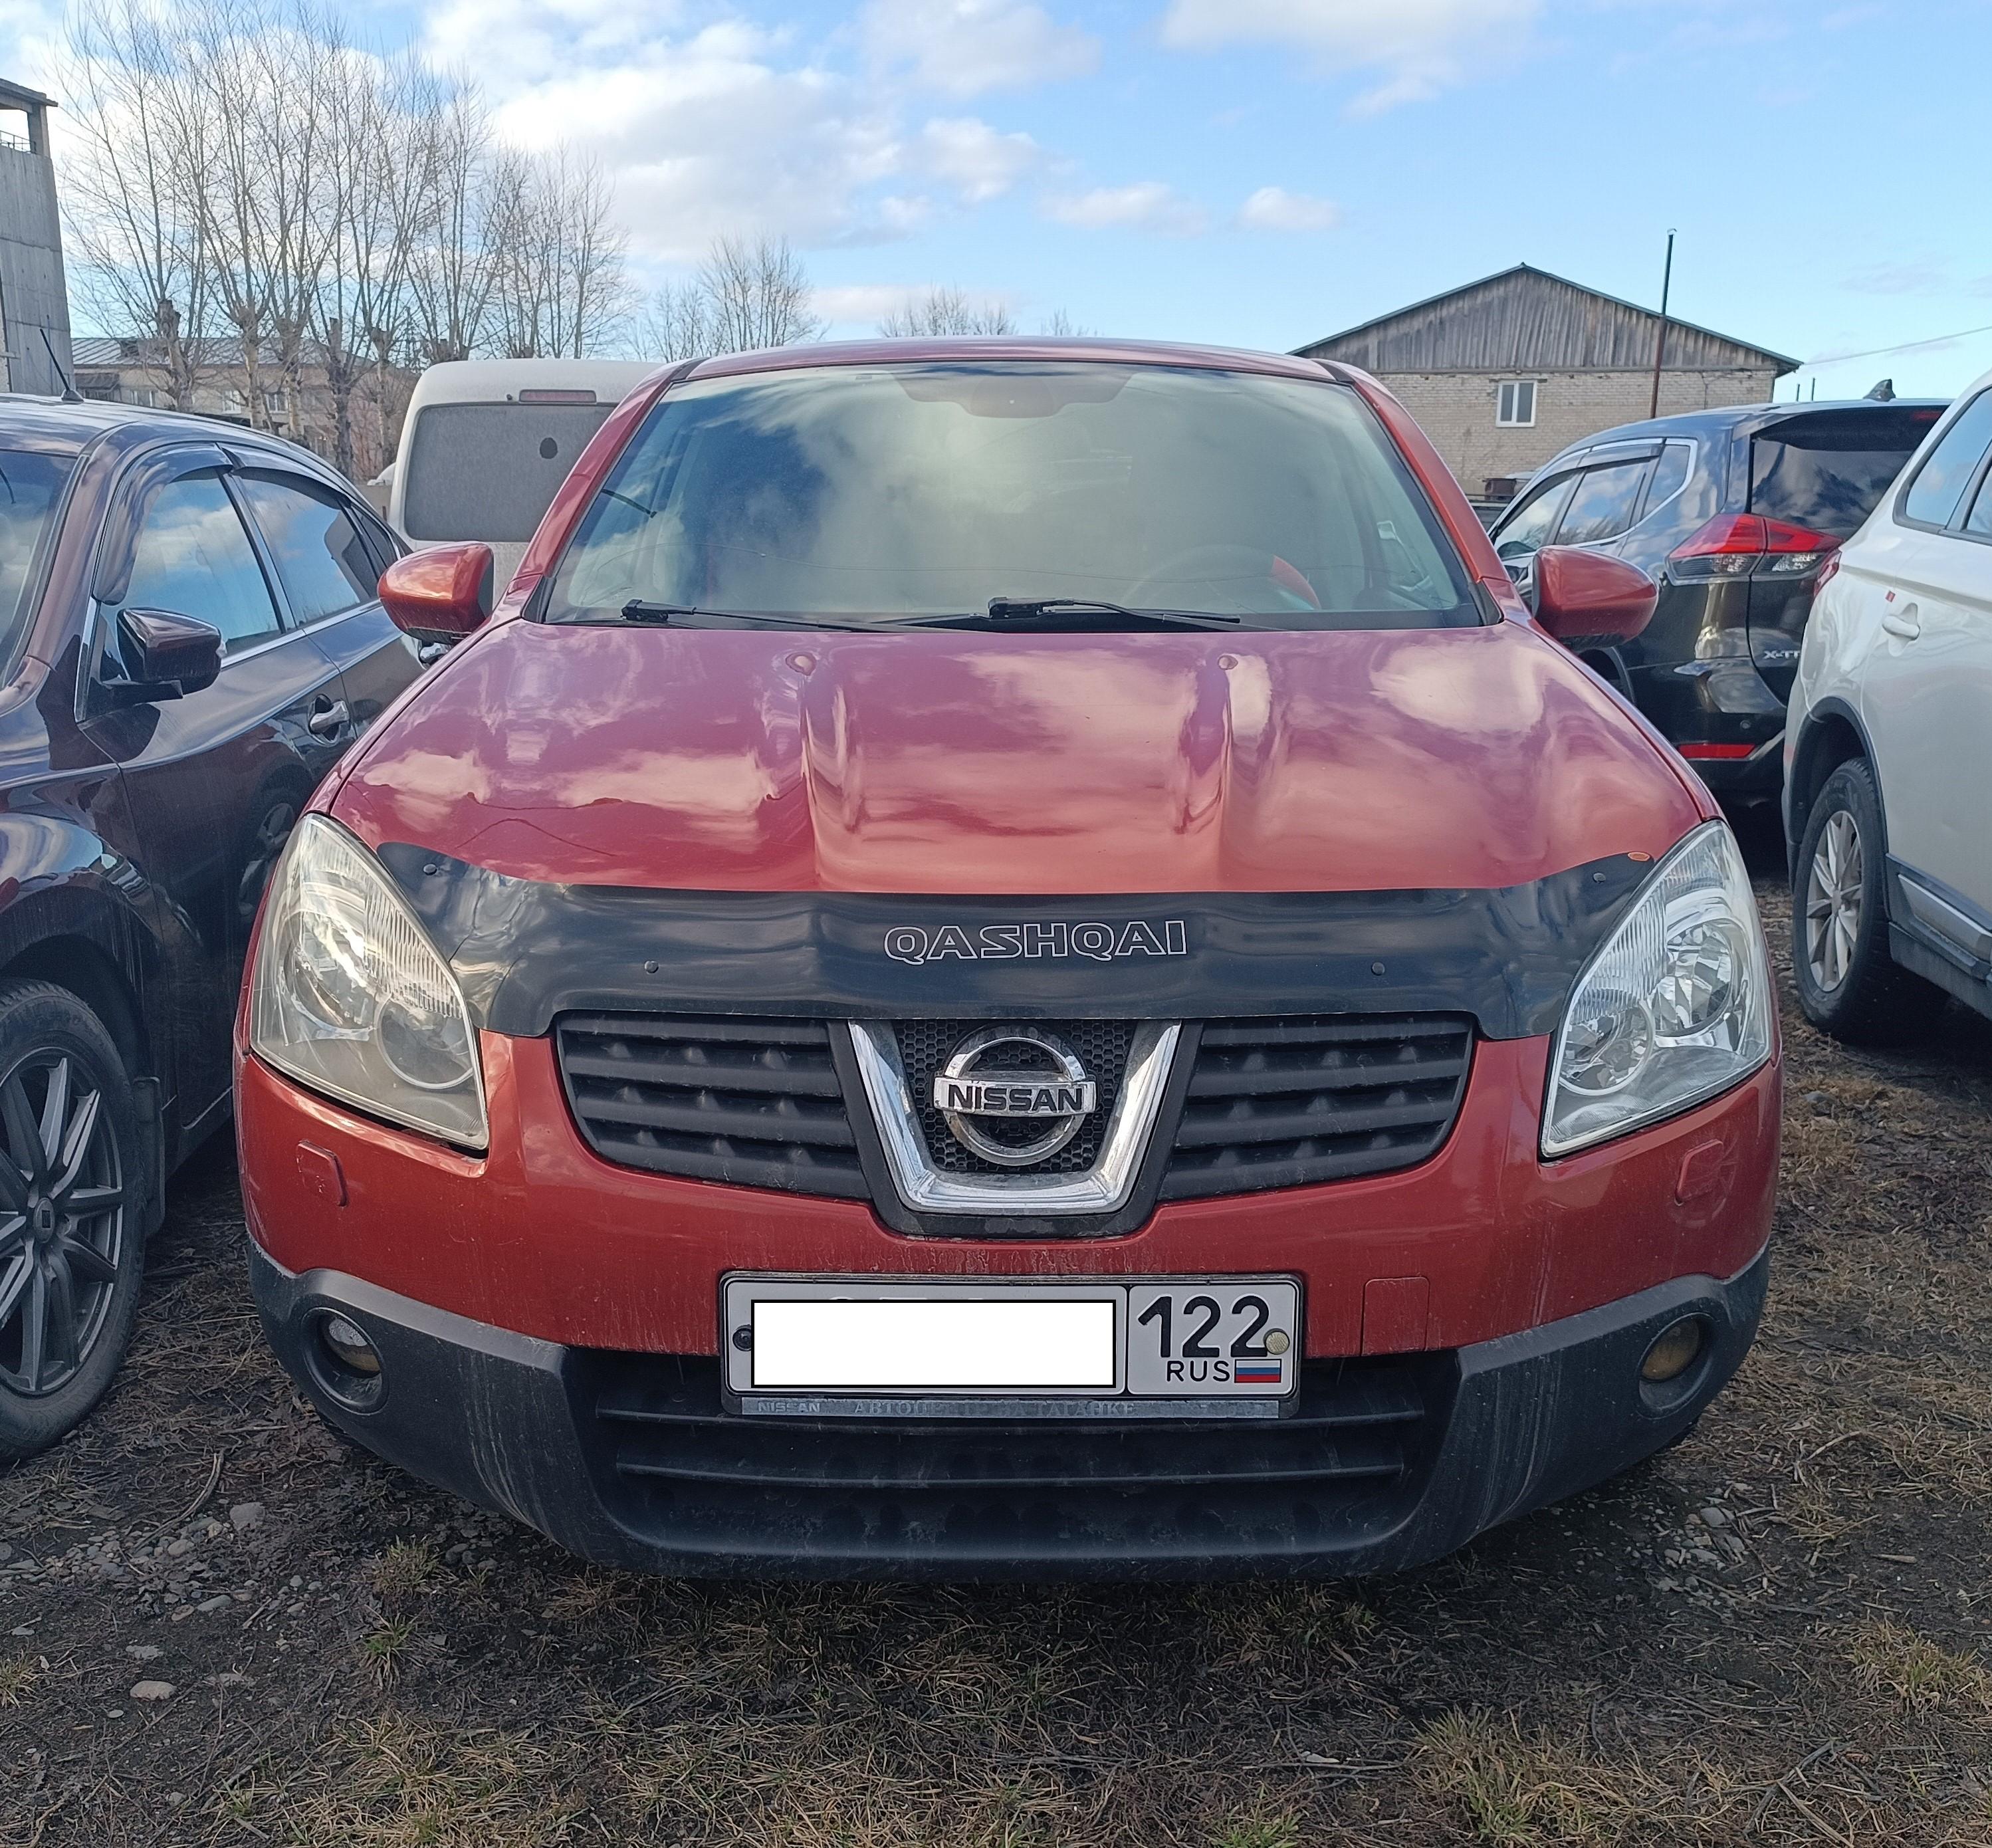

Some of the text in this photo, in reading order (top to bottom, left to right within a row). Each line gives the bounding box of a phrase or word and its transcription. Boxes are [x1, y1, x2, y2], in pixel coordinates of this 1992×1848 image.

[884, 920, 1188, 965] QASHQAI
[948, 1084, 1083, 1112] NISSAN
[1137, 1295, 1269, 1358] 122
[1166, 1360, 1230, 1382] RUS
[758, 1401, 821, 1413] NISSAN
